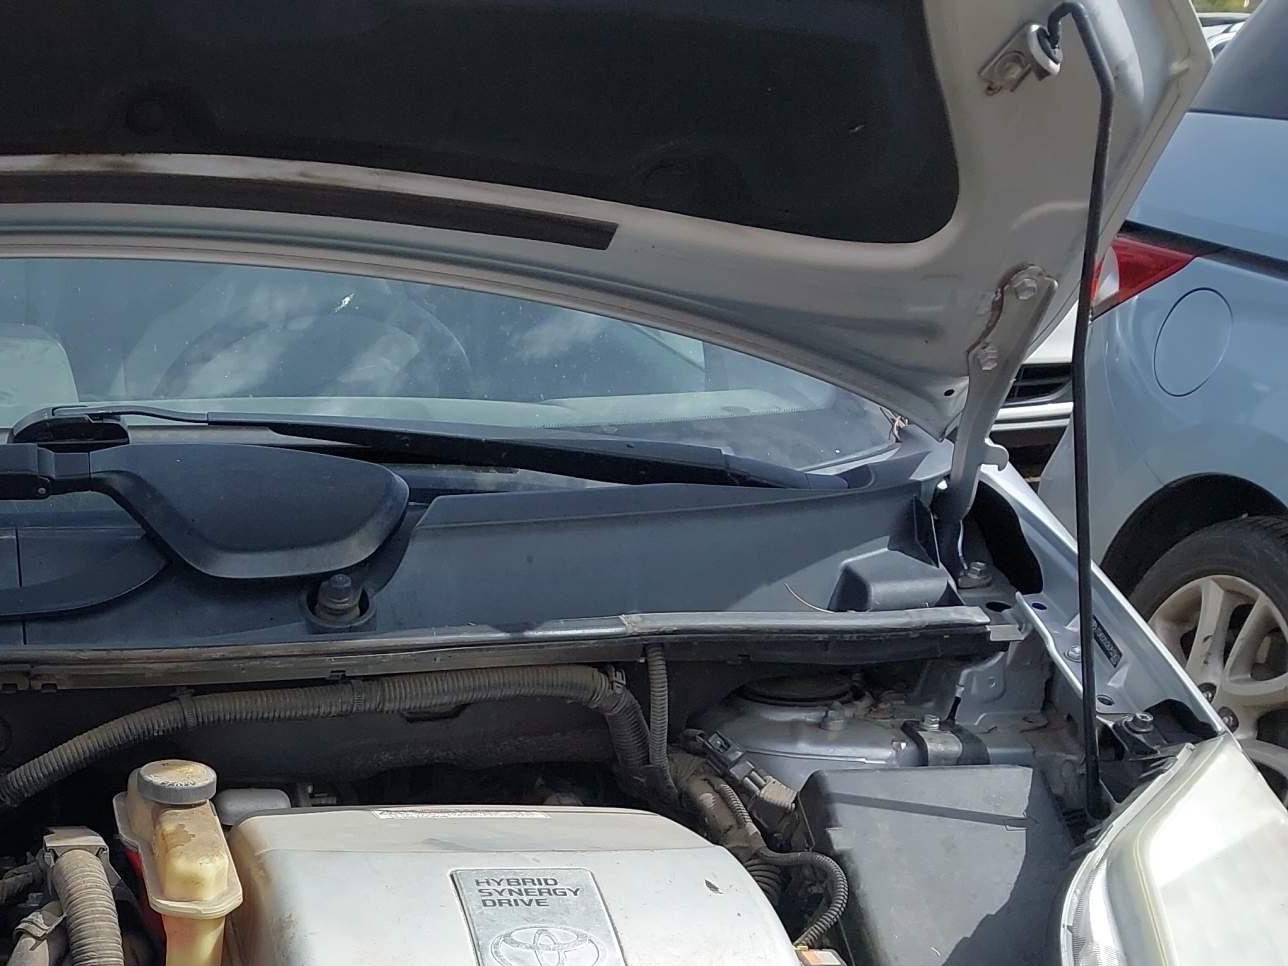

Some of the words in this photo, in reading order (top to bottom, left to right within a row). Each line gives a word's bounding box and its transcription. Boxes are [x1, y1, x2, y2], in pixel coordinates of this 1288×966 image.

[475, 877, 559, 887] HYBRID
[478, 887, 580, 897] SYNERGY
[481, 898, 550, 907] DRIVE
